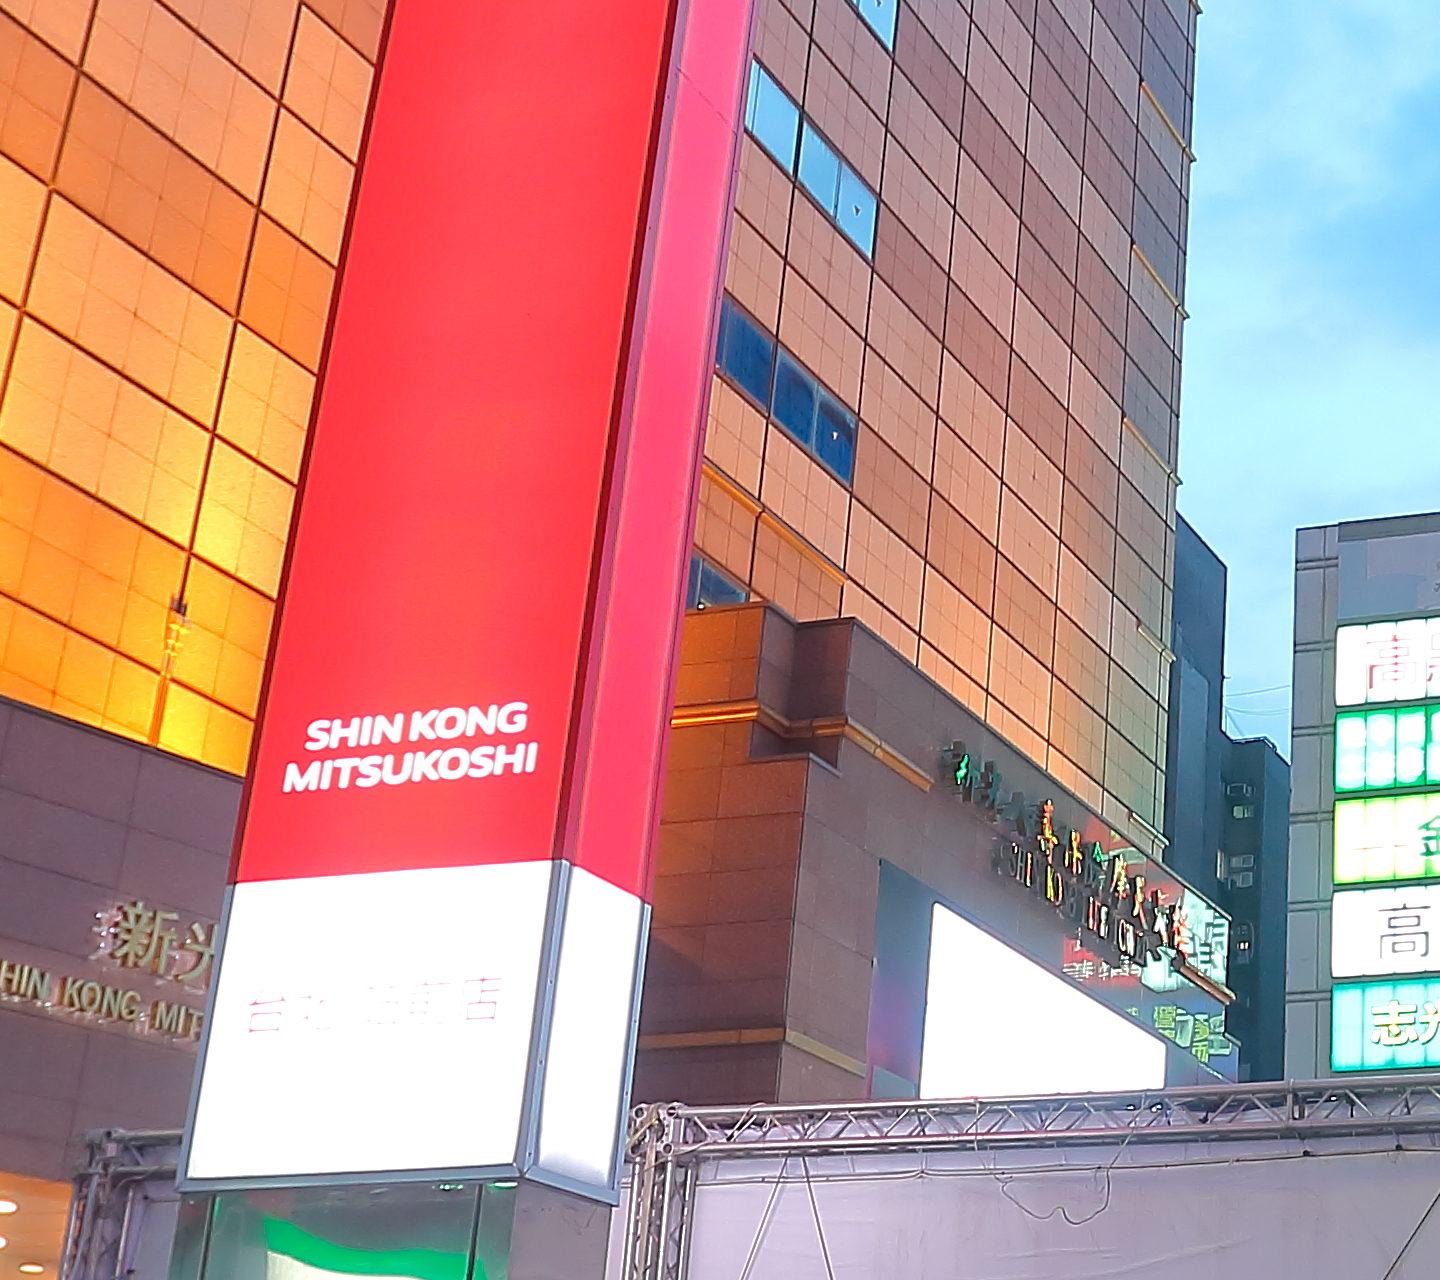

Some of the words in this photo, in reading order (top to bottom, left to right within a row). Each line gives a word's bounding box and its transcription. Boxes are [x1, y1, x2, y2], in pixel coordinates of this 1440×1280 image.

[304, 712, 403, 751] SHIN
[409, 701, 529, 740] KONG
[282, 742, 539, 794] MITSUKOSHI
[61, 977, 141, 1021] KONG
